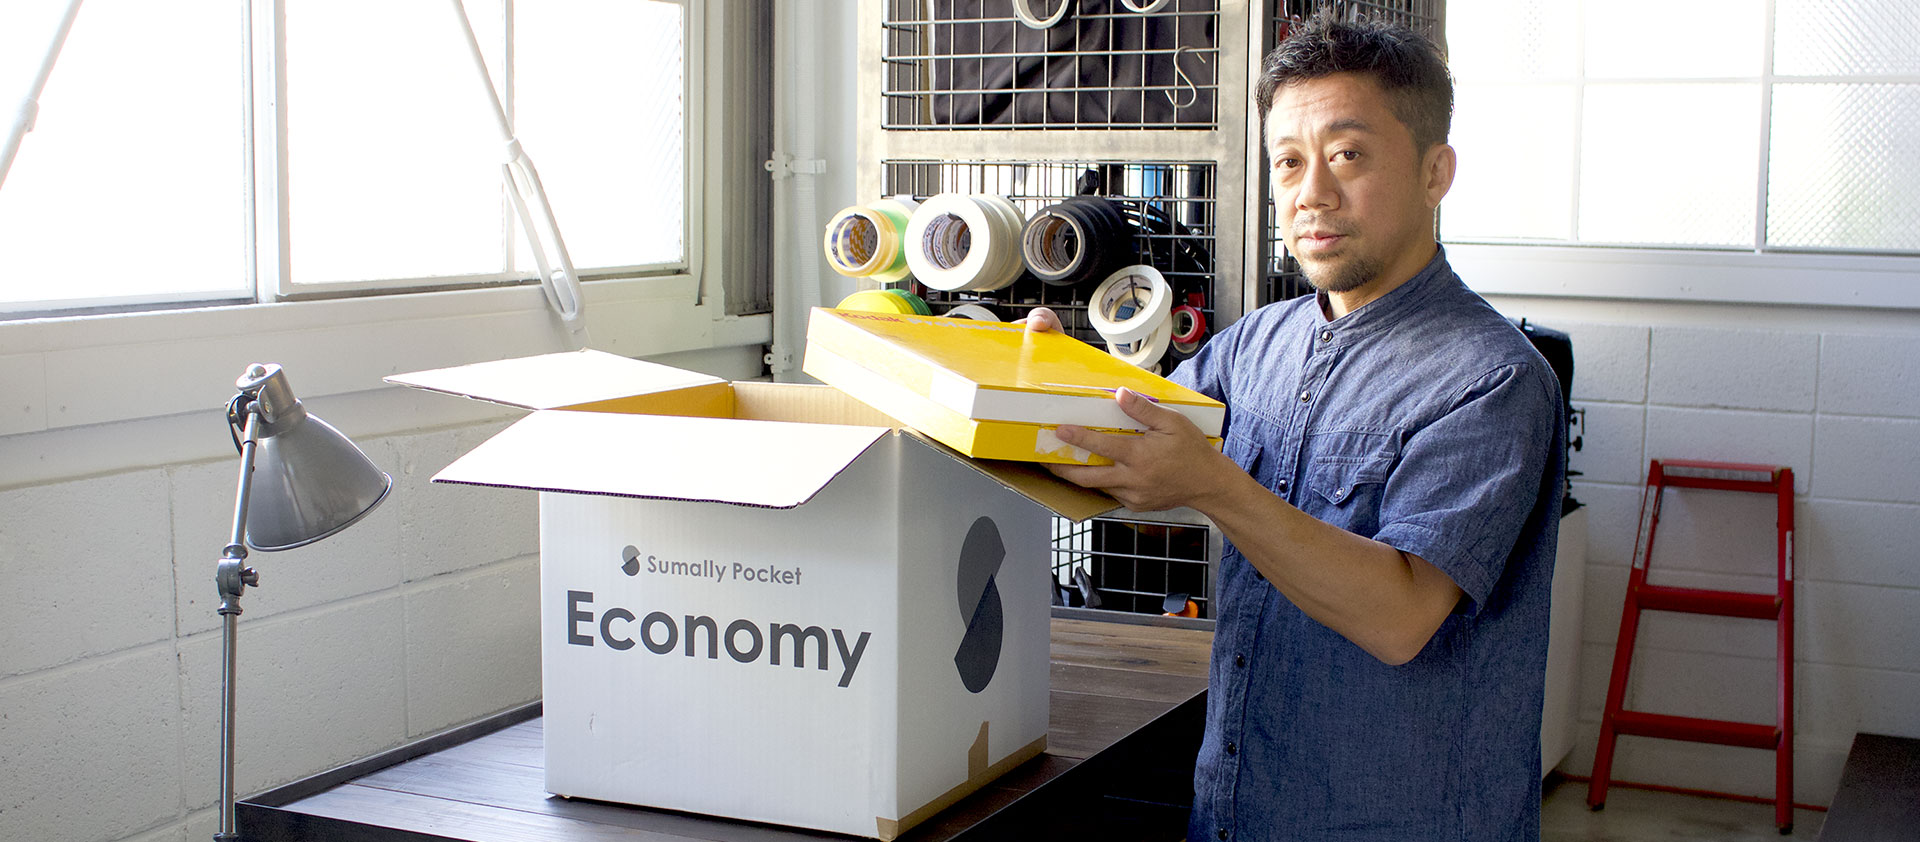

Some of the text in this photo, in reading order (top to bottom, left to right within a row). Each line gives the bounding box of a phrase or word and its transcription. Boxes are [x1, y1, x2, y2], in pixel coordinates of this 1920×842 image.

[837, 311, 904, 323] Kodak
[648, 555, 803, 585] Sumally Pocket
[567, 589, 872, 688] Economy
